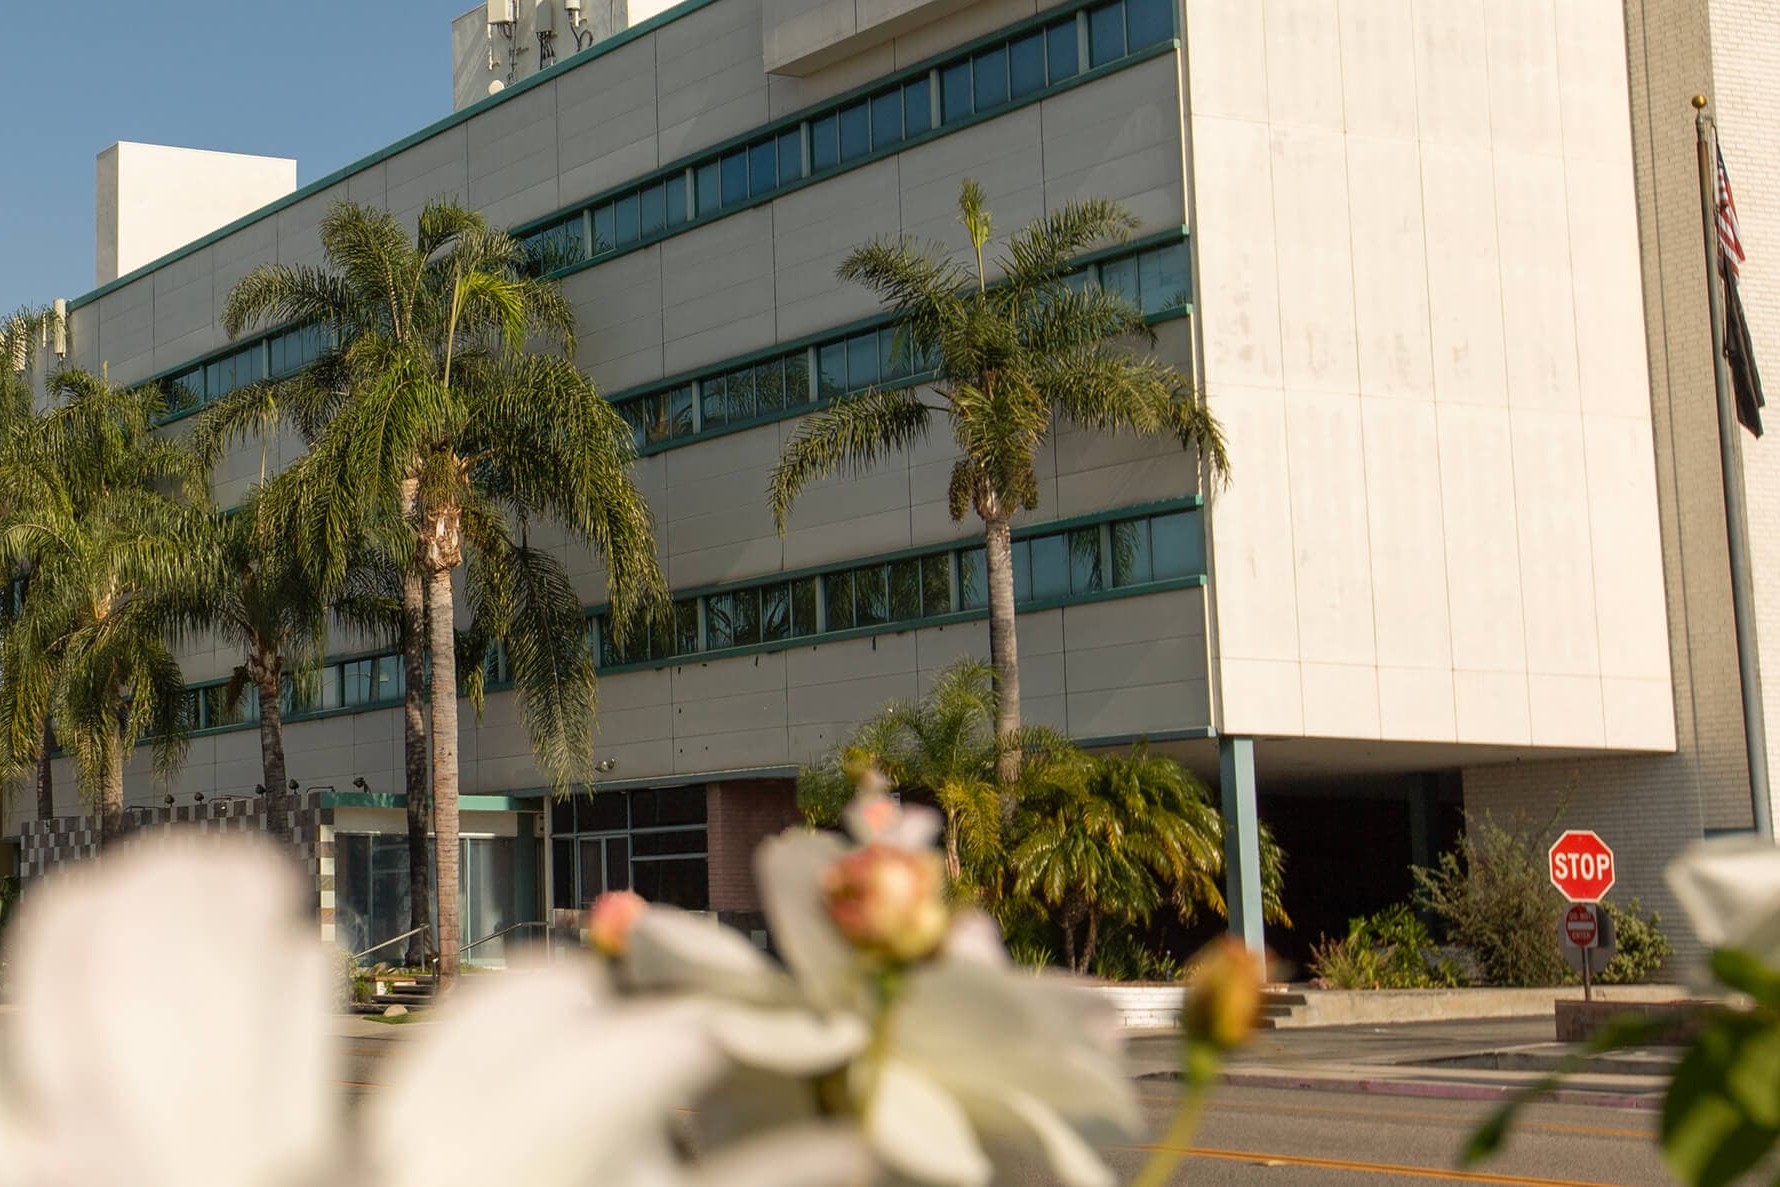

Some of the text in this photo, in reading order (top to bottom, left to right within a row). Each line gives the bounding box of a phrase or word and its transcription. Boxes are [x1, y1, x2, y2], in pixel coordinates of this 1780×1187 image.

[1555, 853, 1610, 880] STOP
[1568, 911, 1593, 921] DO NOT
[1571, 931, 1591, 940] ENTER
